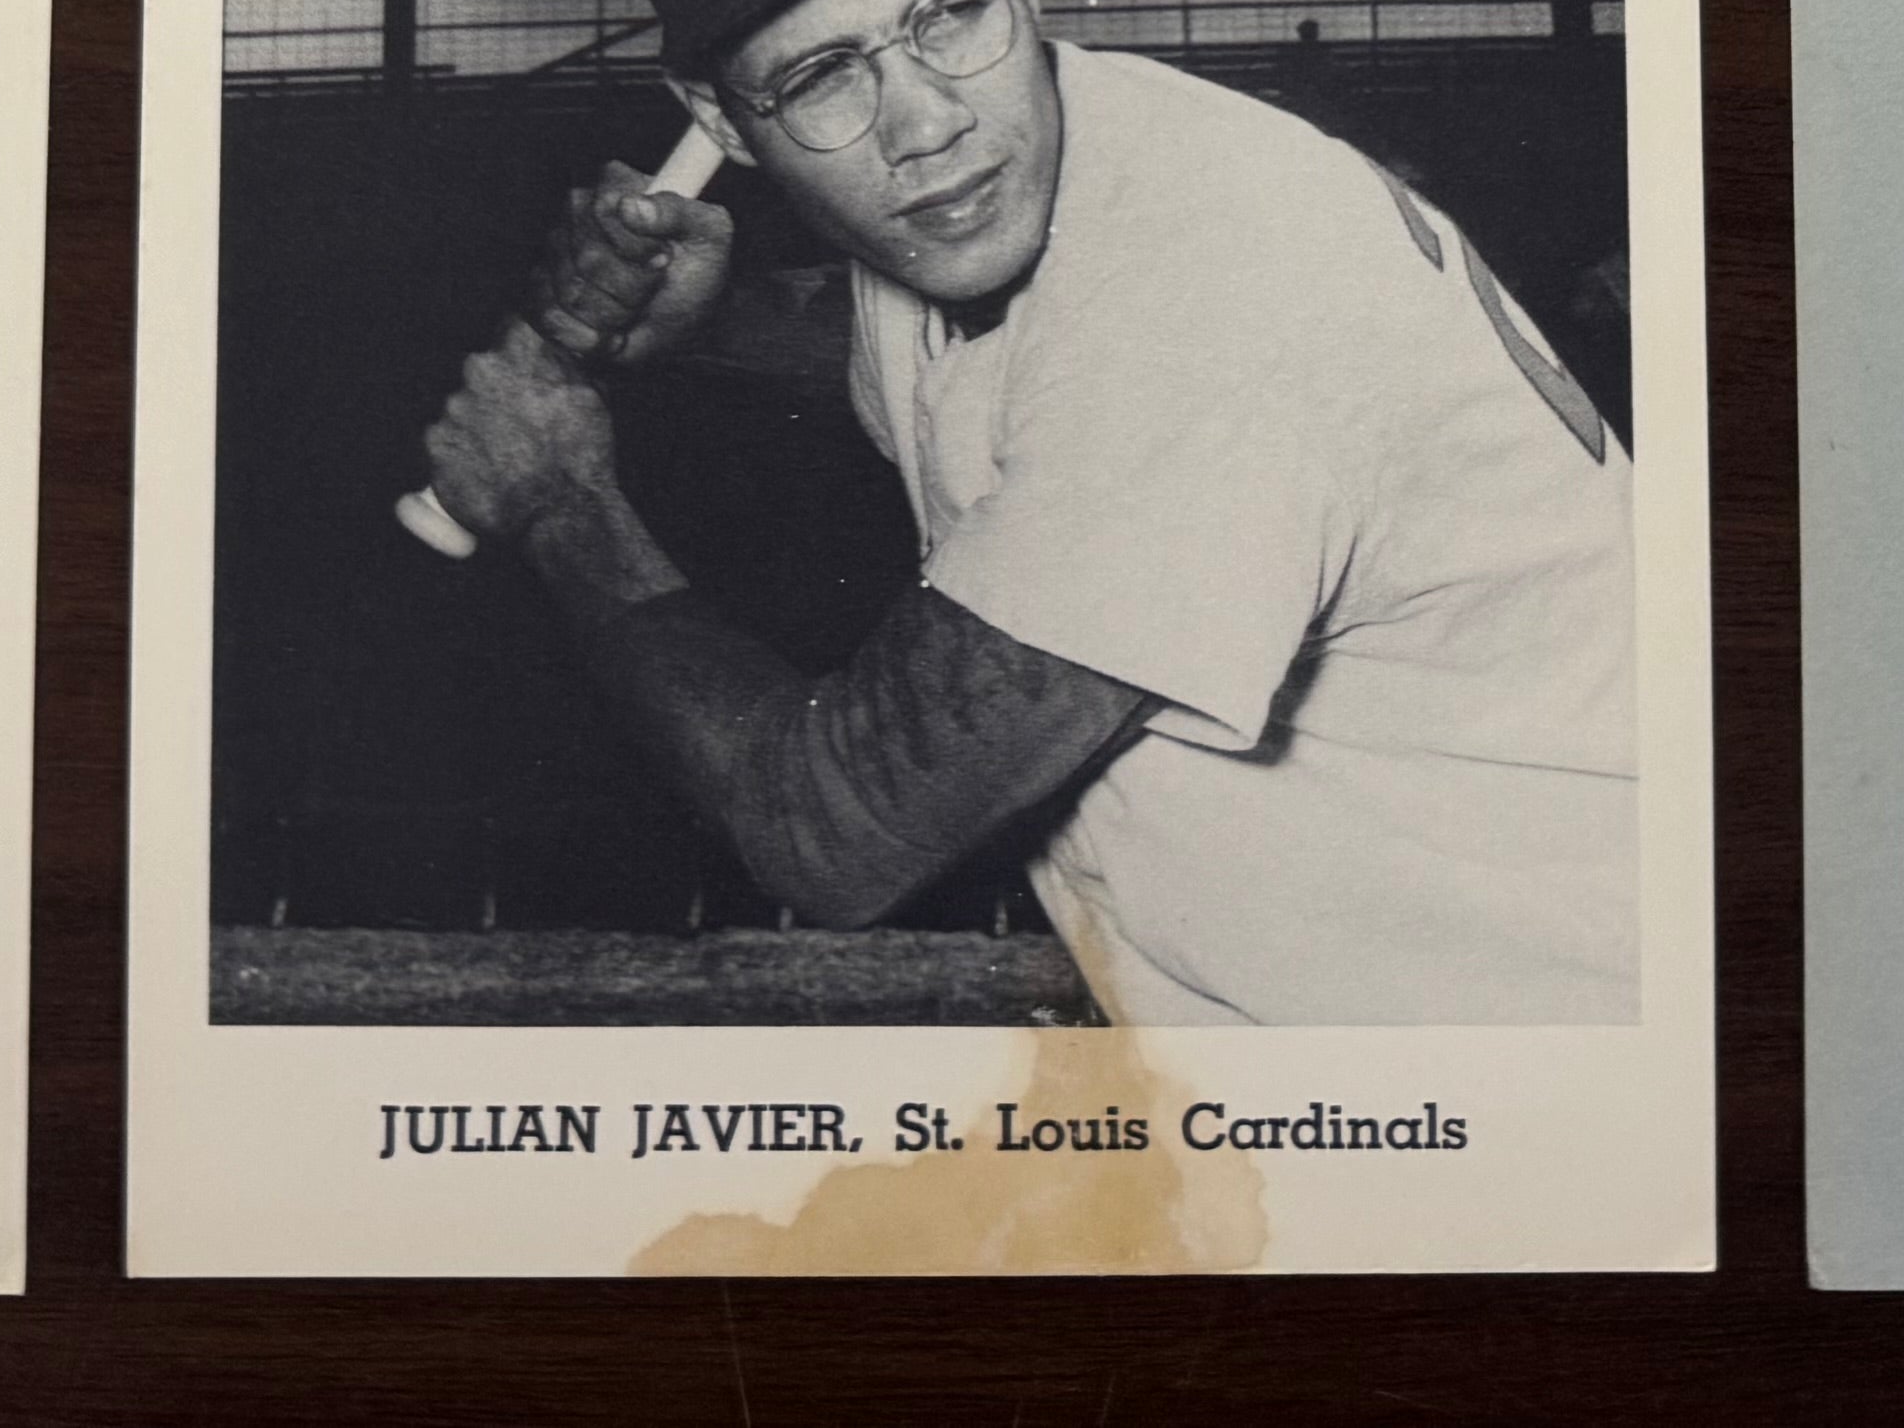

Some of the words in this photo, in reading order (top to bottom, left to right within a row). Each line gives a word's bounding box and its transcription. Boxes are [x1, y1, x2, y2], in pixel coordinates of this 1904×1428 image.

[378, 1104, 602, 1160] JULIAN
[630, 1103, 864, 1160] JAVIER,
[894, 1101, 965, 1153] St.
[995, 1102, 1150, 1153] Louis
[1180, 1101, 1469, 1152] Cardinals
